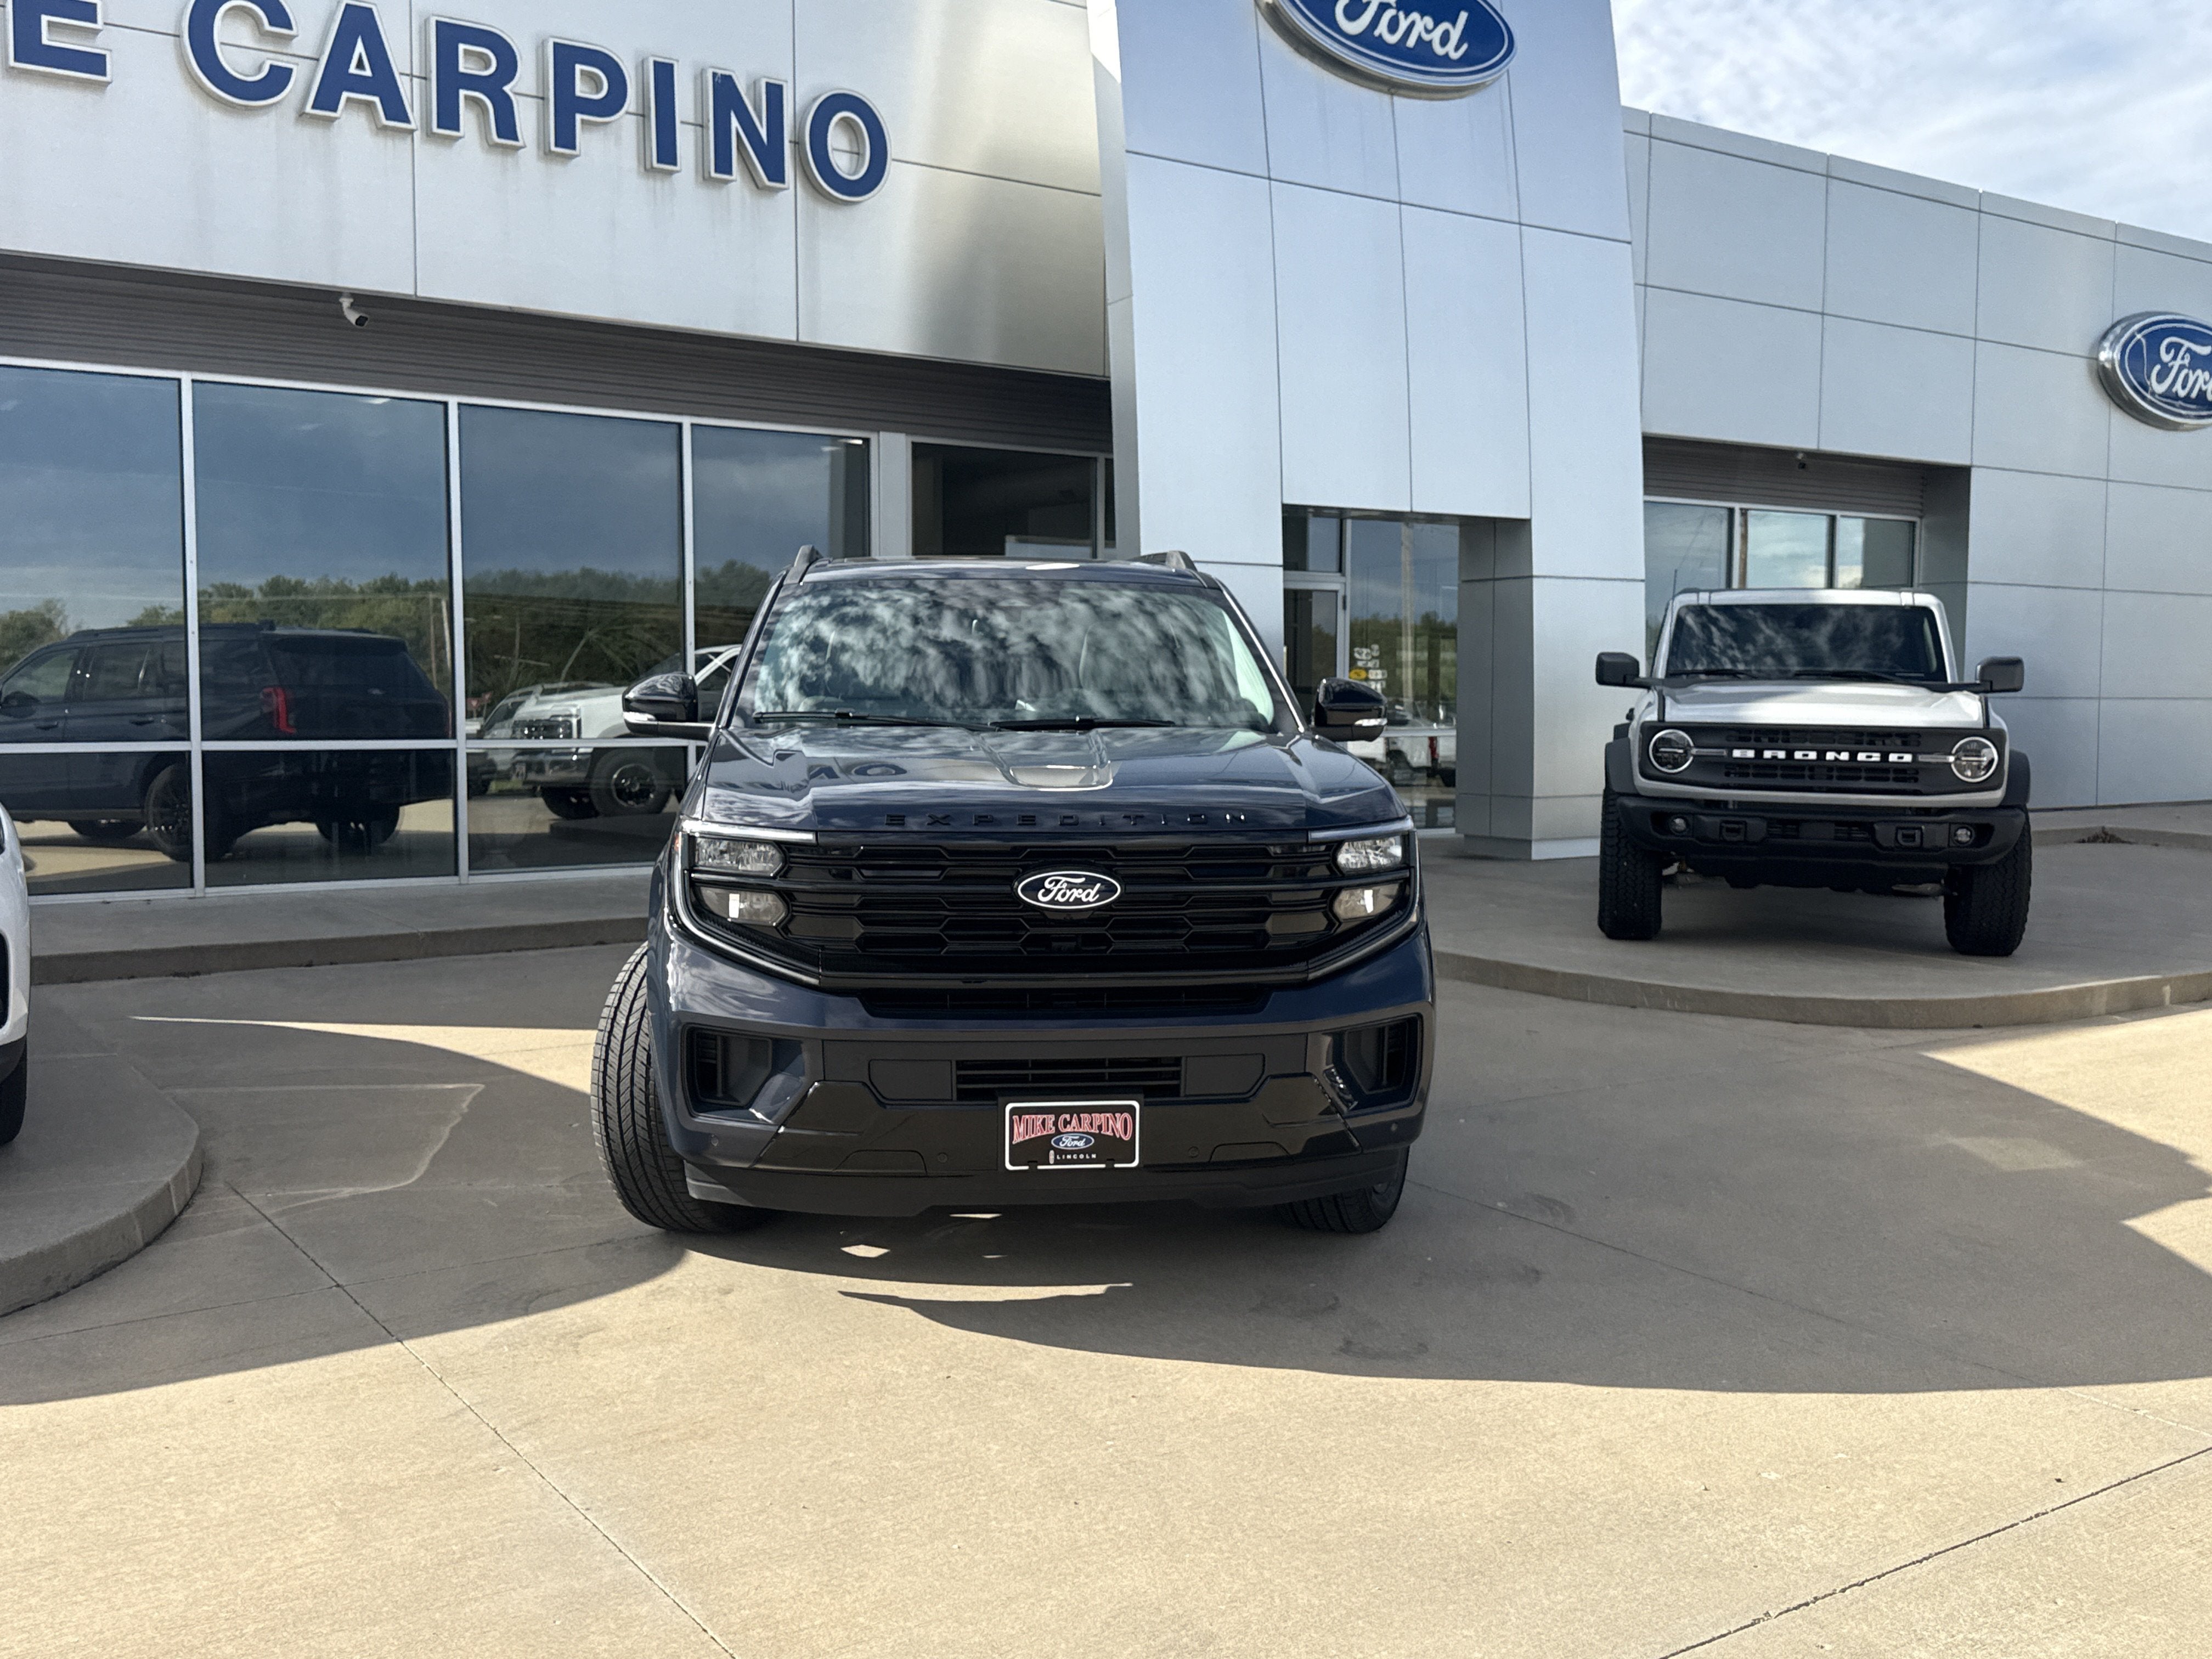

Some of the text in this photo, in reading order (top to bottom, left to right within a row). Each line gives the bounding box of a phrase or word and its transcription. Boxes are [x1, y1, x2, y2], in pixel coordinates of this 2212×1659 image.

[181, 0, 892, 204] CARPINO
[2151, 336, 2212, 402] For
[1731, 748, 1913, 763] BRONCO
[884, 812, 1248, 827] EXPEDITION
[1037, 876, 1101, 902] Ford
[1012, 1113, 1133, 1144] MIKE CARPINO
[1059, 1136, 1086, 1147] Ford
